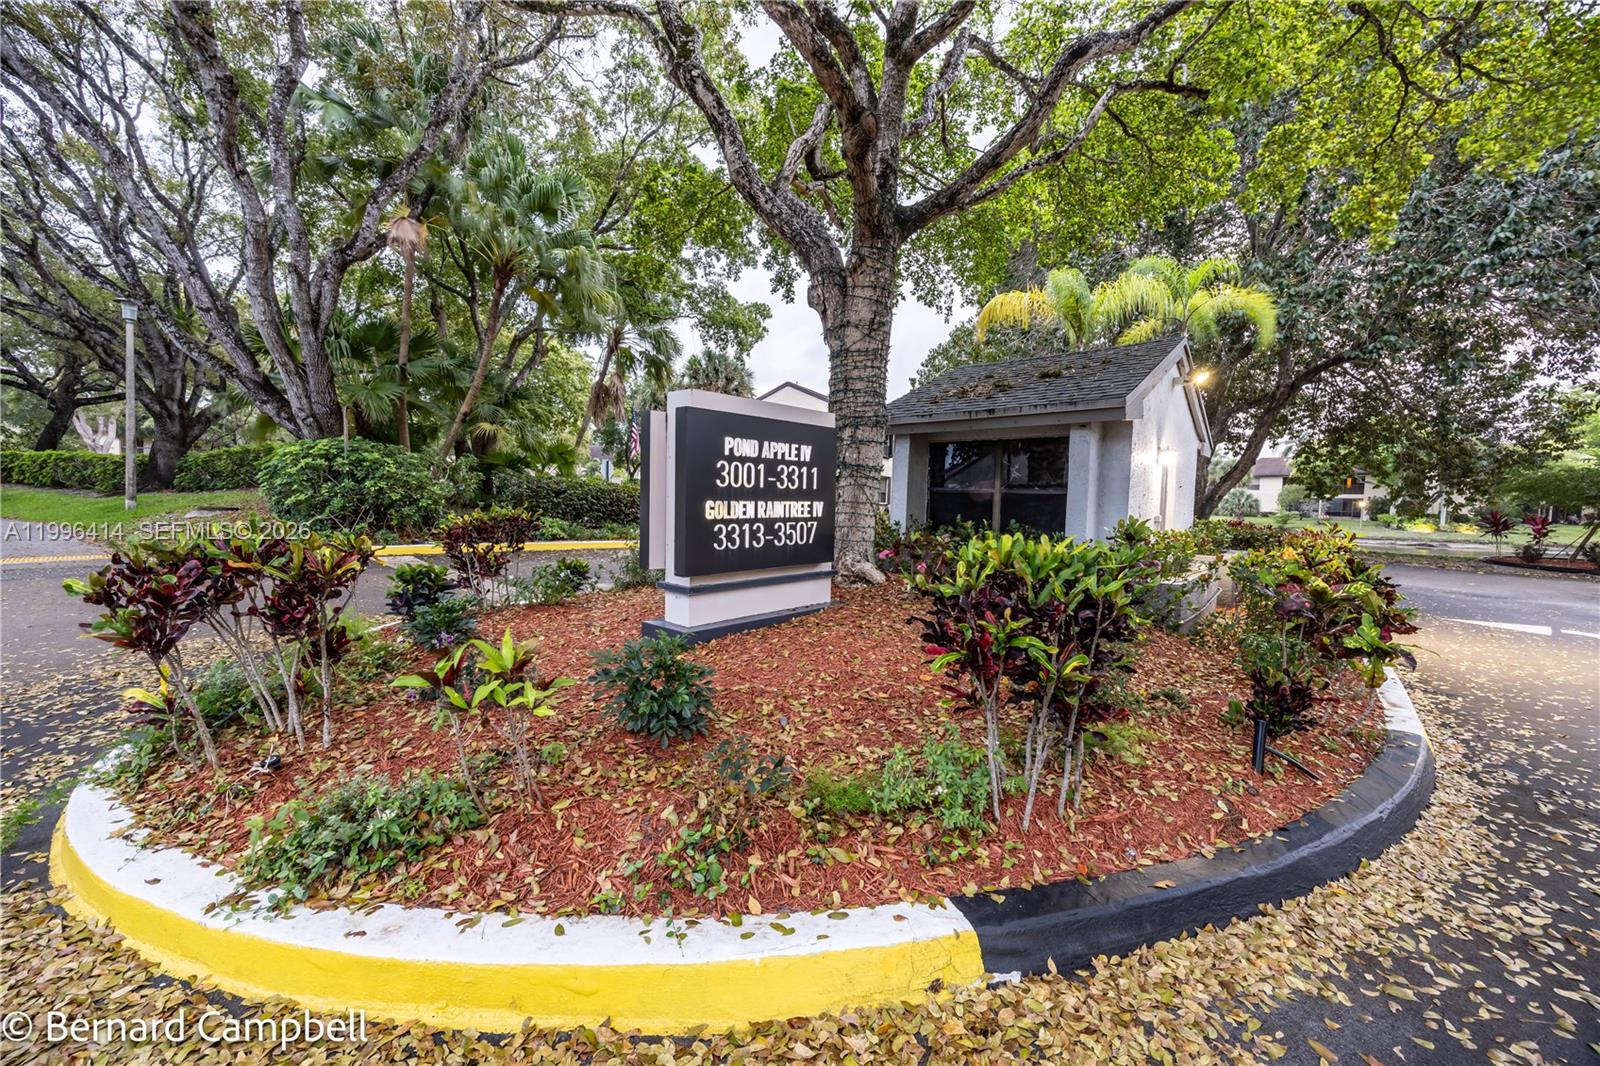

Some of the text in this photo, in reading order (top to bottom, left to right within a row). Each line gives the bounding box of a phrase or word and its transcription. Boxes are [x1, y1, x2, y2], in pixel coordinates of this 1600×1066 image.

[724, 437, 812, 462] POND APPLE IV
[715, 460, 818, 490] 3001-3311
[705, 500, 824, 520] GOLDEN RAINTREE IV
[713, 521, 818, 551] 3313-3507
